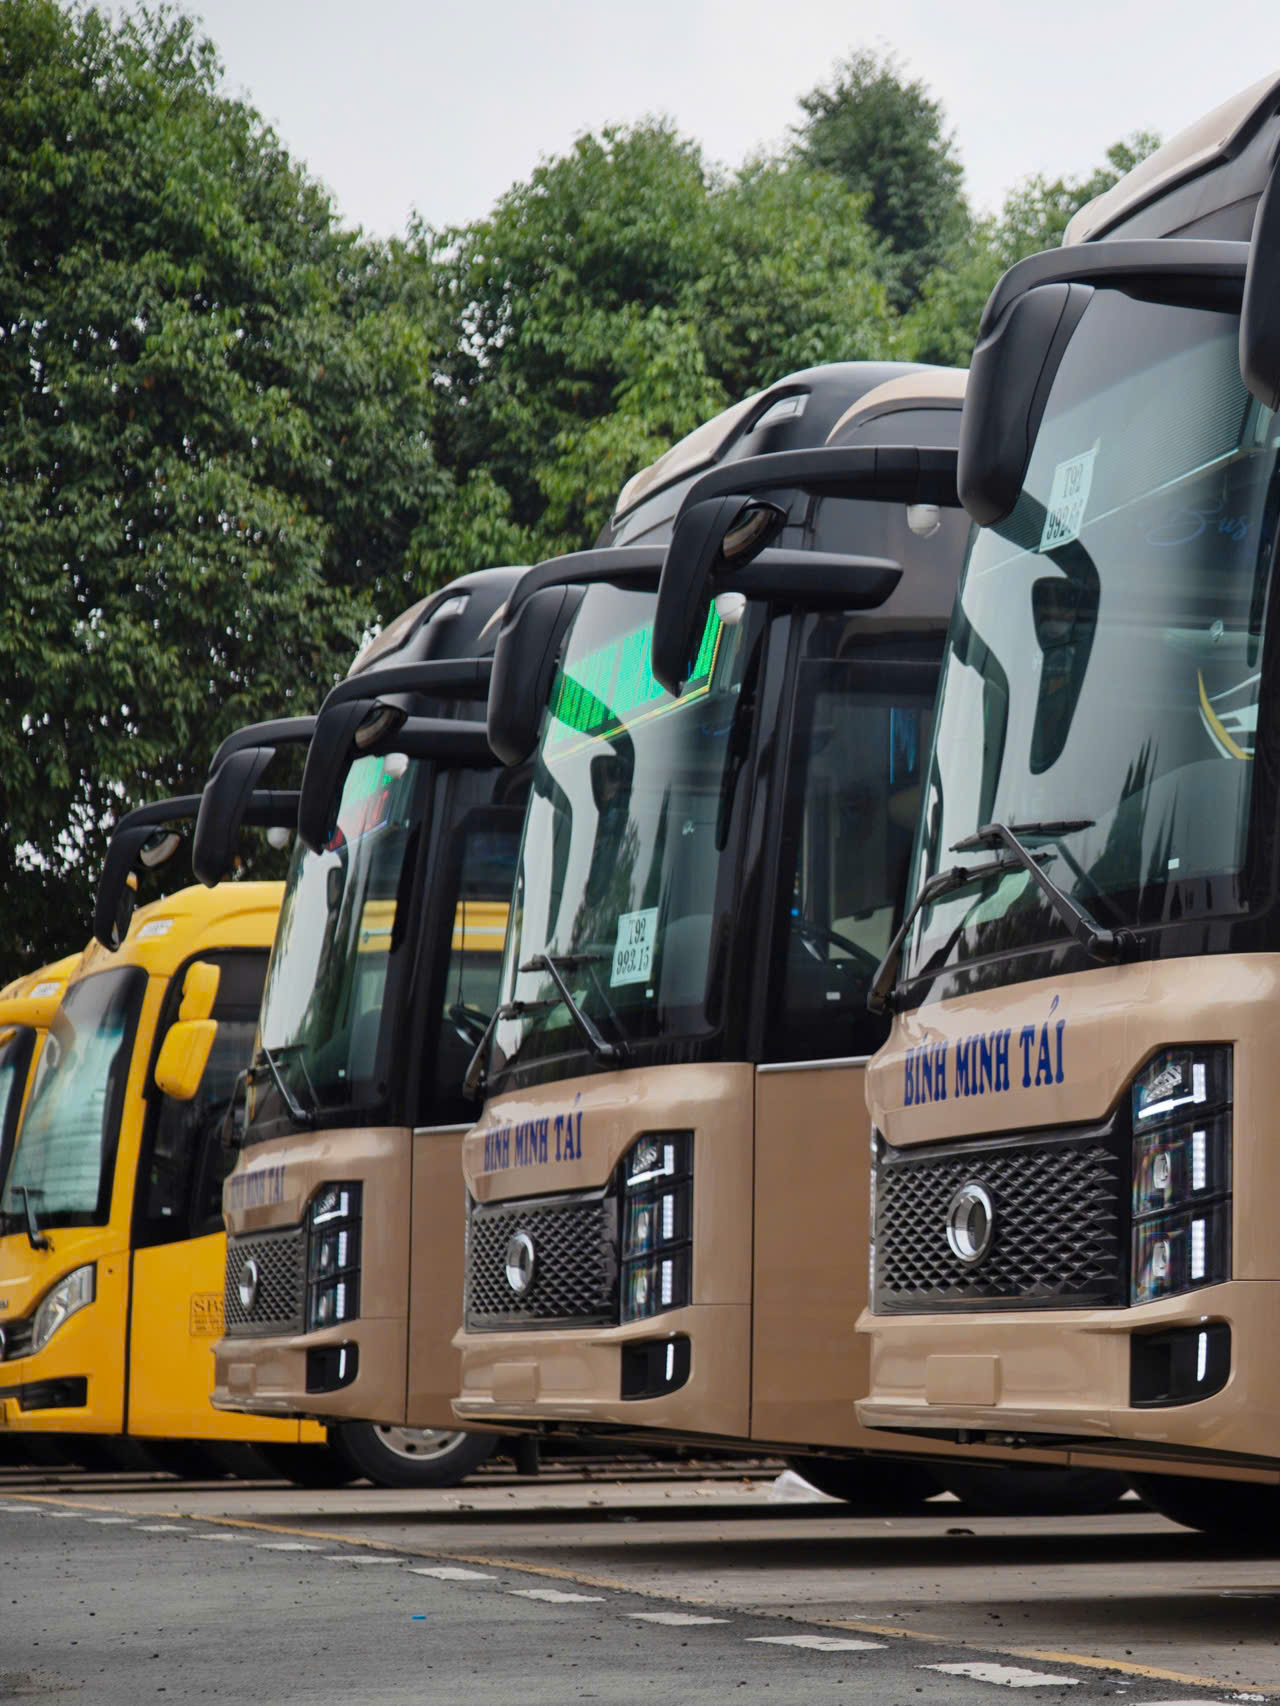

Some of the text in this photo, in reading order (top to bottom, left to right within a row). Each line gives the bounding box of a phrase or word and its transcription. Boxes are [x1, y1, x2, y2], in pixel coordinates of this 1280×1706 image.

[628, 917, 647, 945] T92
[616, 945, 650, 975] 993.15
[955, 1028, 1011, 1098] MINH
